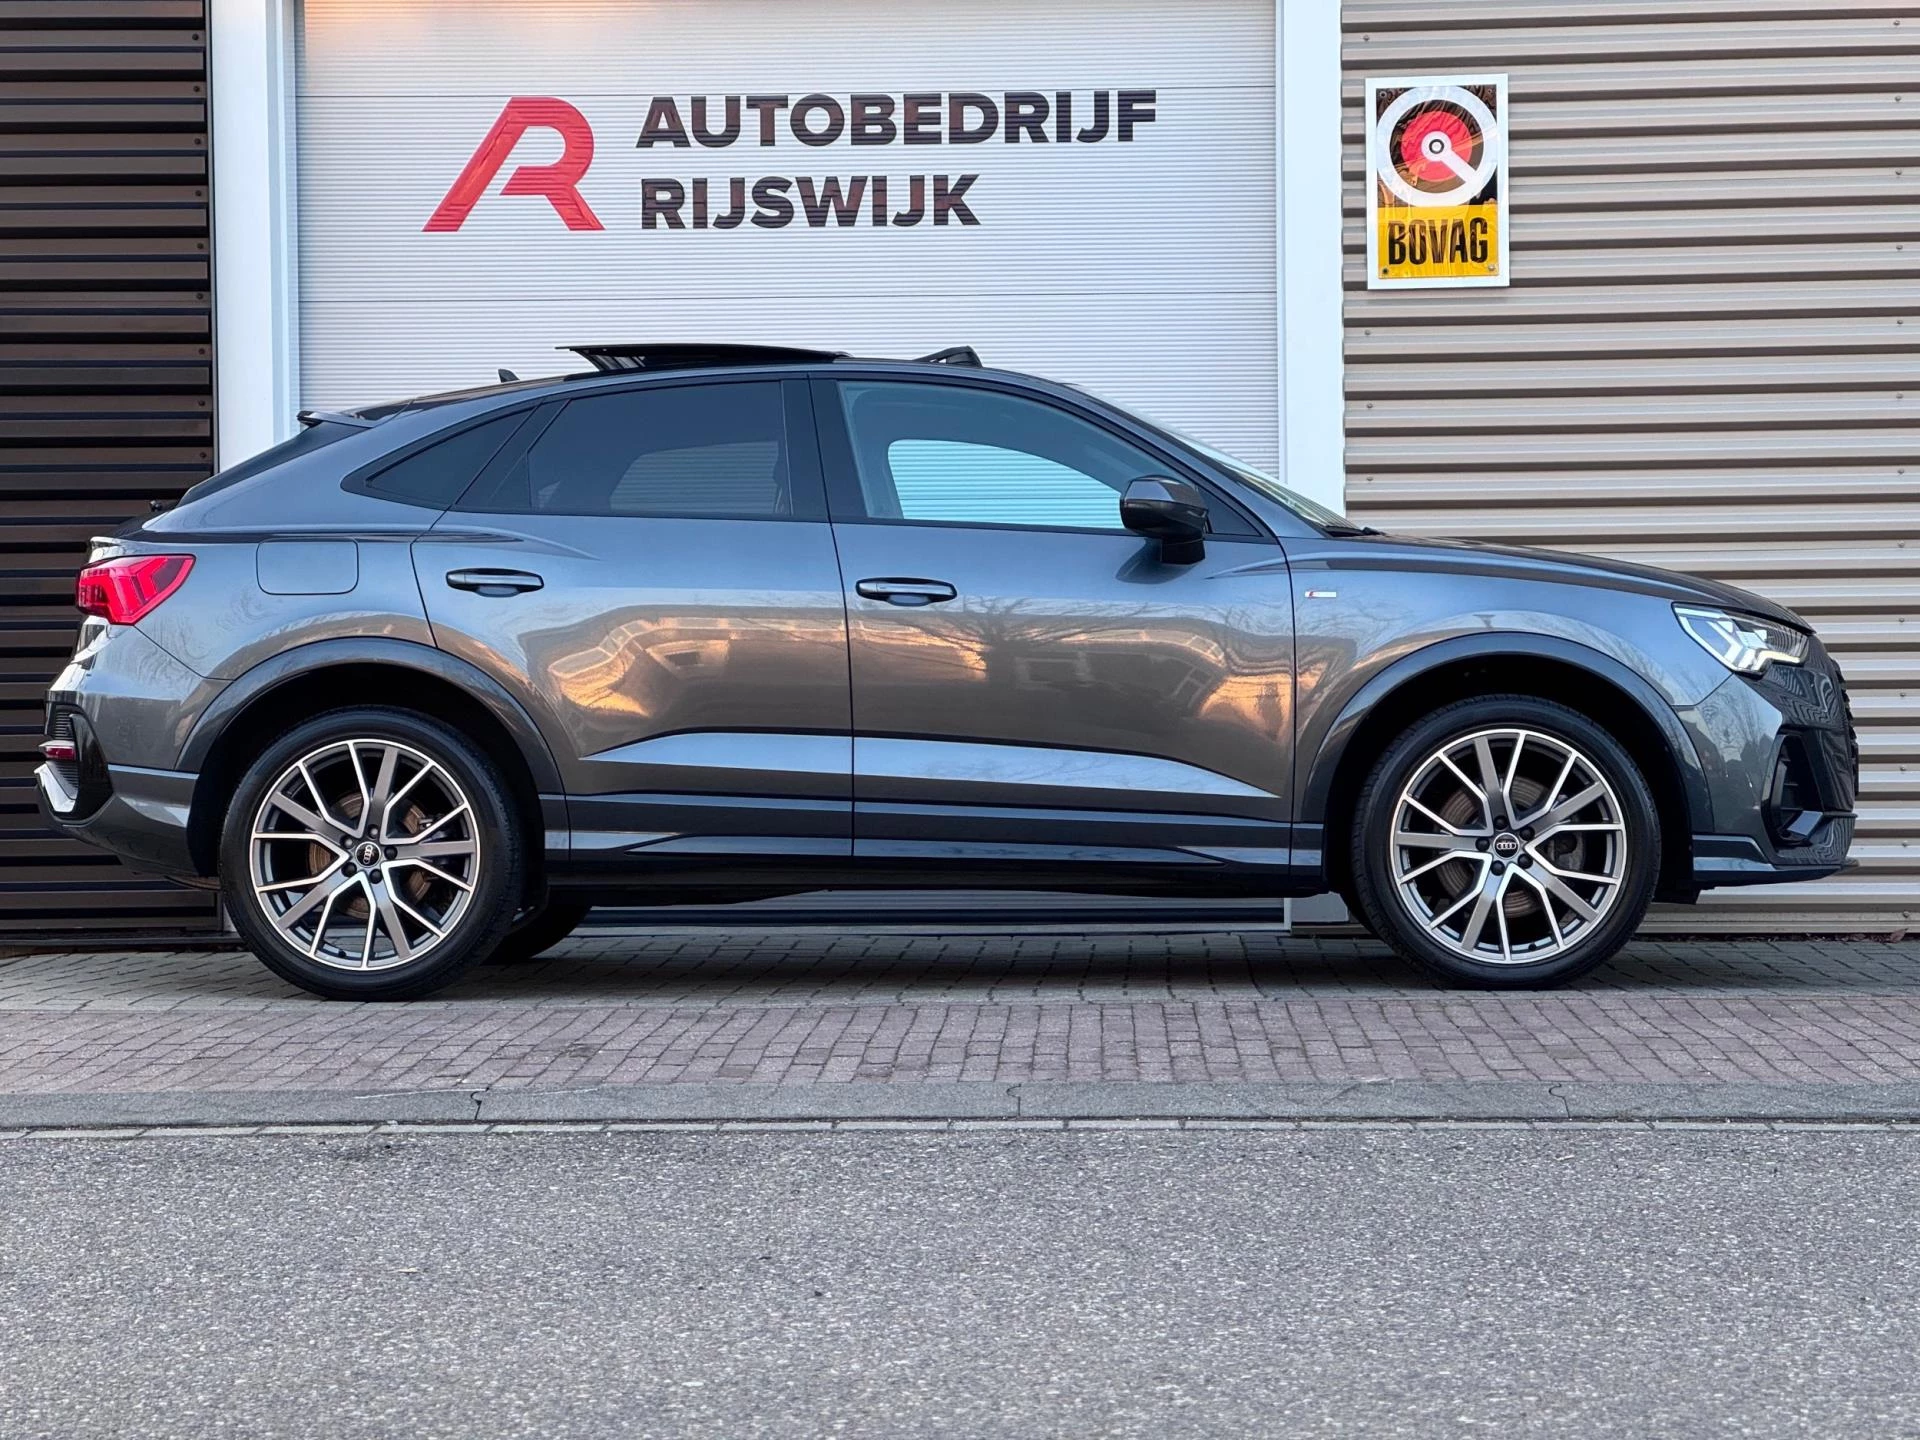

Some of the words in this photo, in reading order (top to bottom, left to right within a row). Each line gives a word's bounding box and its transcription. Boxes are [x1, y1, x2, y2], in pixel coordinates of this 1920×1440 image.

[635, 89, 1157, 149] AUTOBEDRIJF
[641, 173, 981, 230] RIJSWIJK
[1388, 216, 1488, 266] BOVAG
